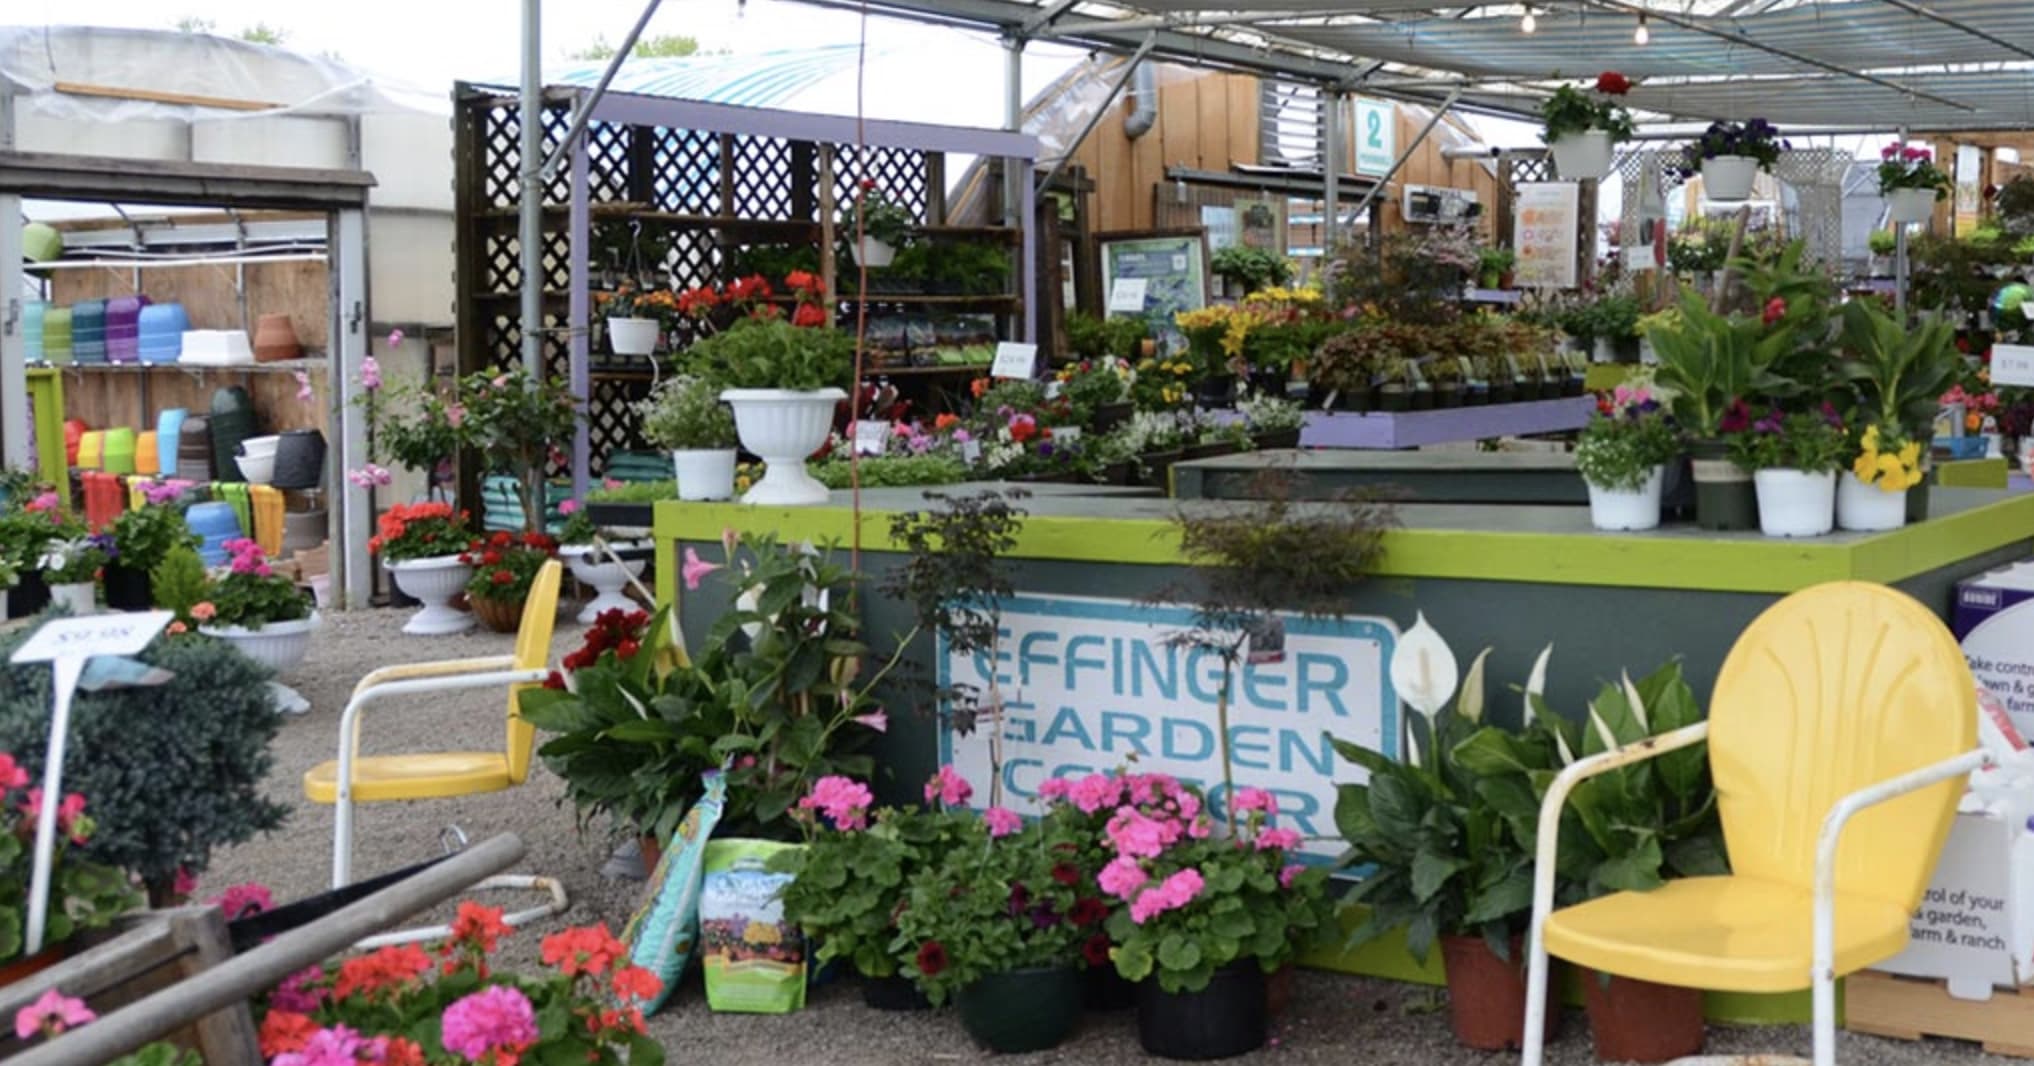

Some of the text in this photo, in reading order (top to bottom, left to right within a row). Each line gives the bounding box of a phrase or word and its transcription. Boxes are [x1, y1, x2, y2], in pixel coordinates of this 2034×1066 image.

[1367, 109, 1382, 148] 2
[972, 626, 1349, 717] EFFINGER
[2013, 680, 2024, 693] &
[1001, 701, 1334, 777] GARDEN
[1002, 758, 1320, 836] CER
[1949, 890, 1966, 905] of
[1968, 896, 2005, 911] your
[1927, 910, 1986, 930] garden,
[1946, 929, 1957, 943] &
[1960, 935, 2006, 951] ranch
